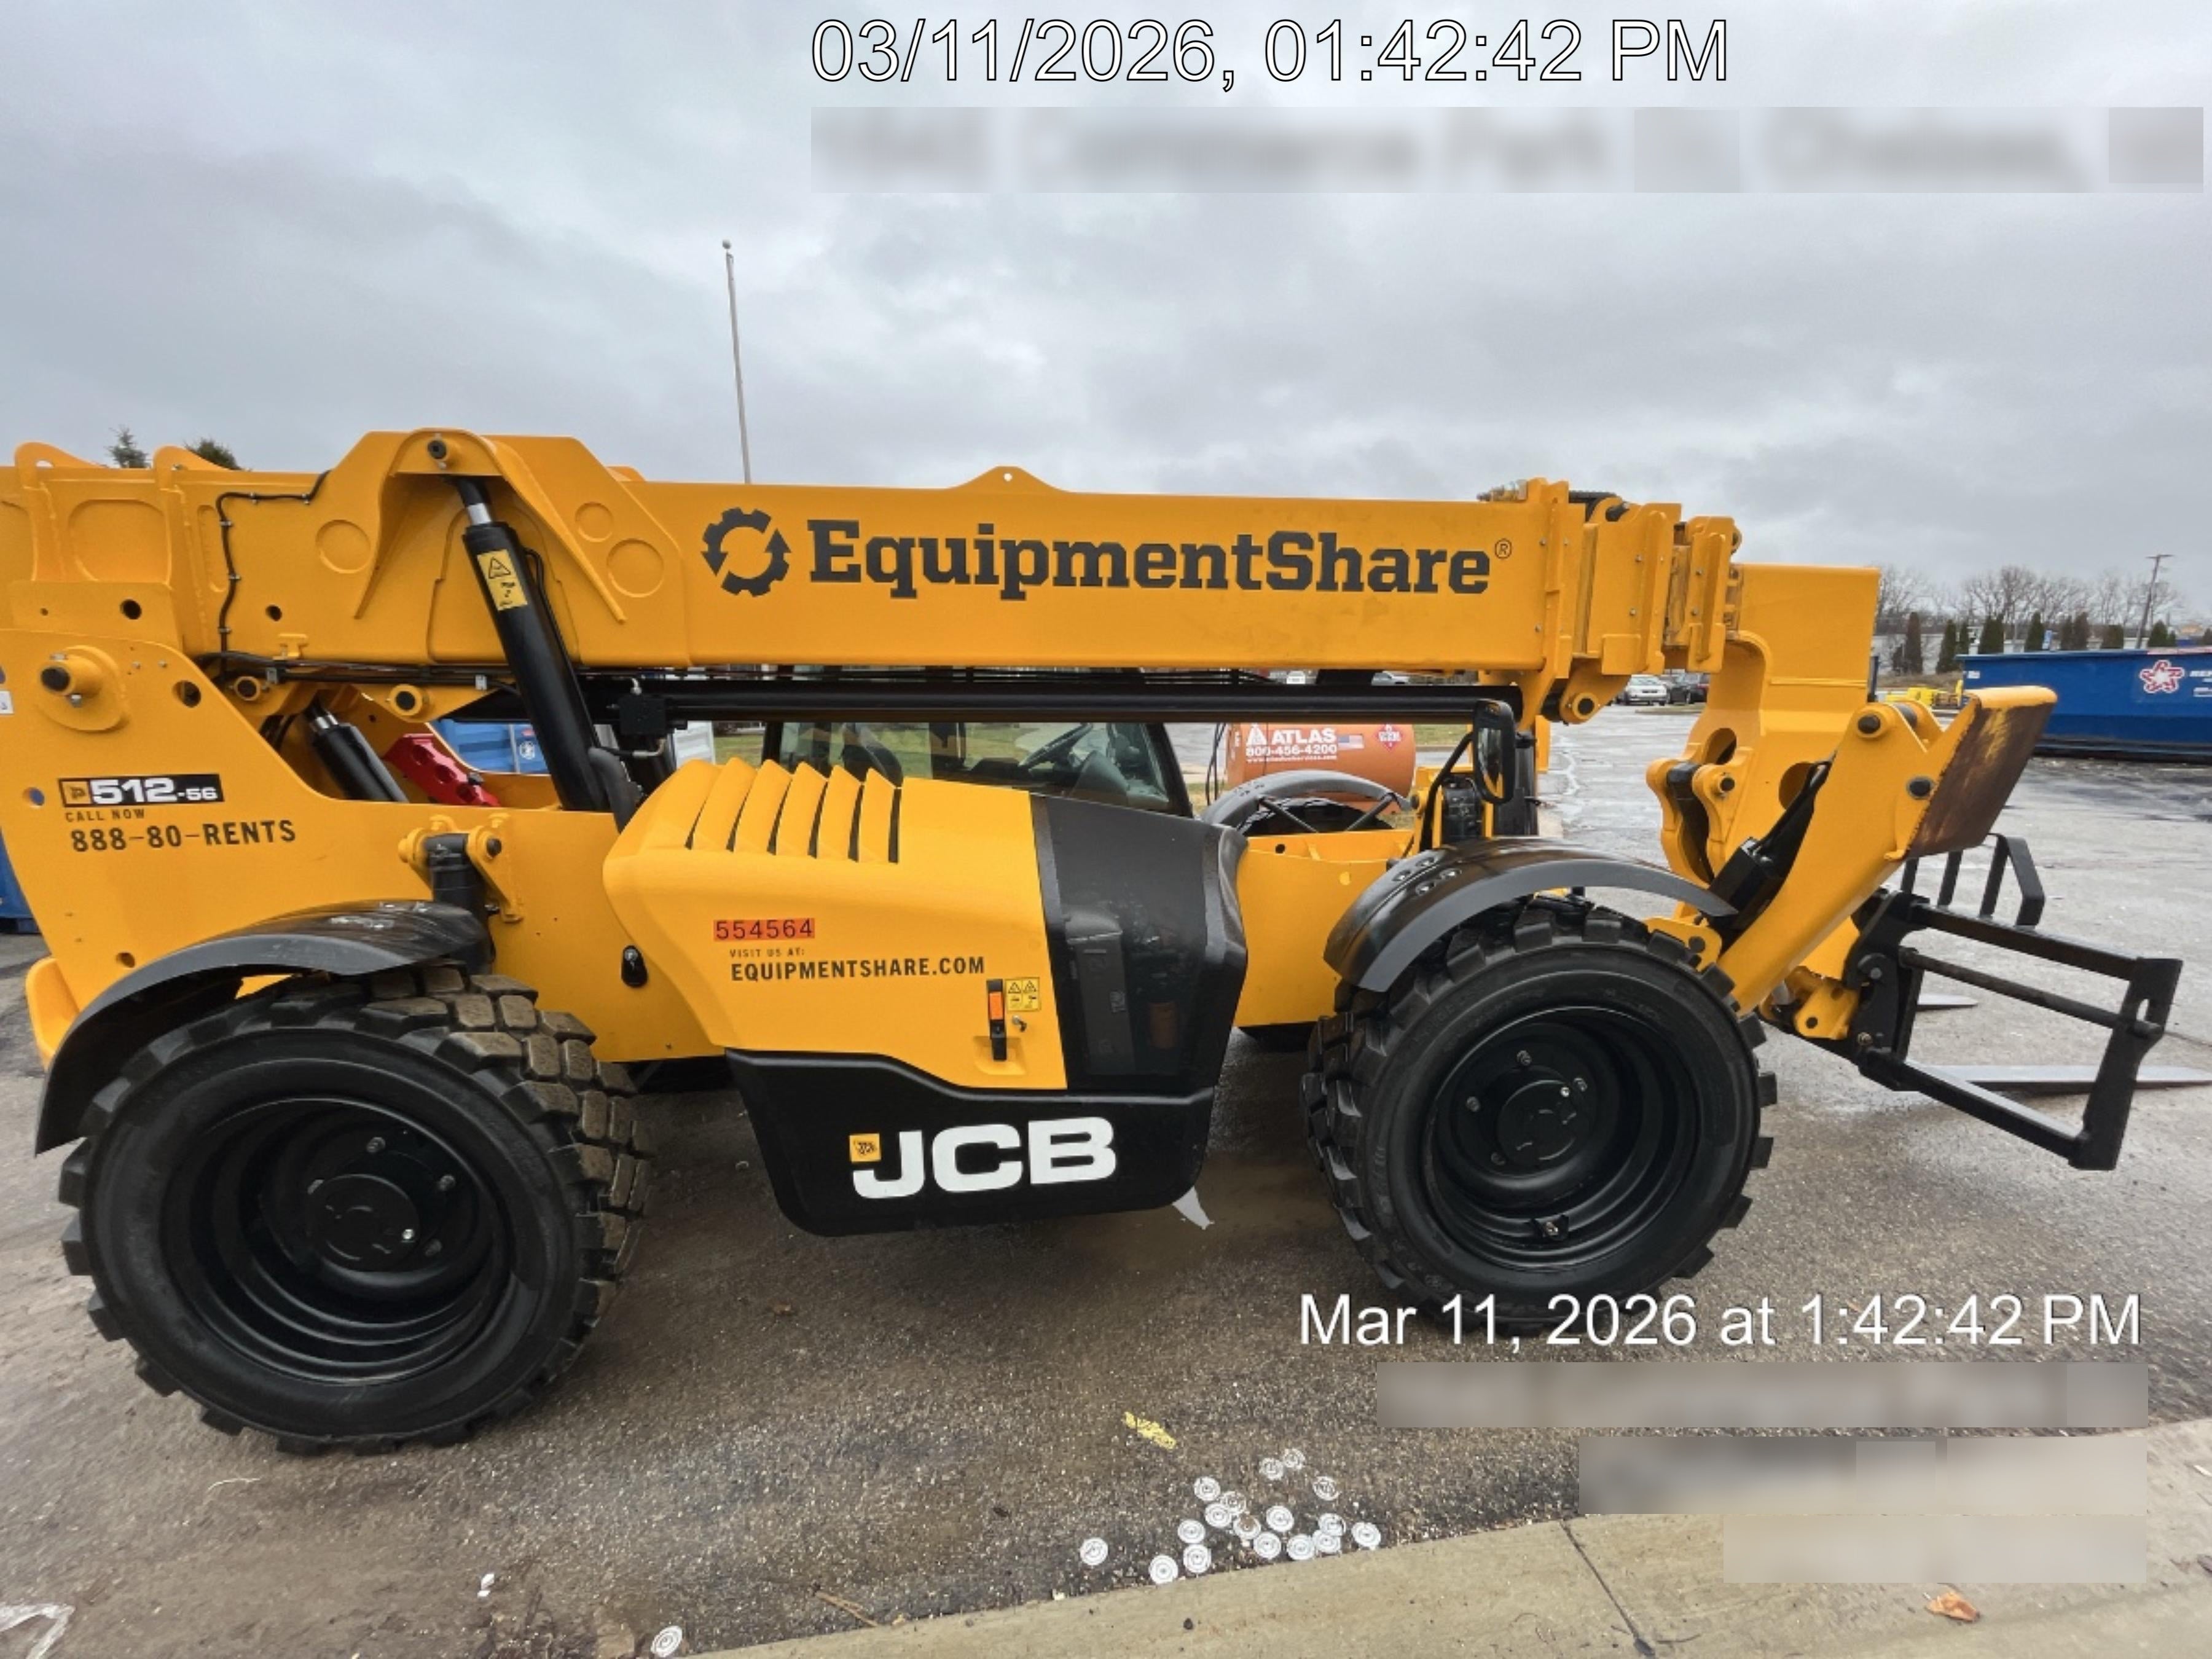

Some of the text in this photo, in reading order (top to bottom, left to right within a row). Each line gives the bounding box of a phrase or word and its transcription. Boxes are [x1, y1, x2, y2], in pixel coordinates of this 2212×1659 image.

[1271, 728, 1337, 745] ATLAS
[1245, 744, 1337, 756] 800-456-4200
[90, 777, 218, 804] 512-56
[65, 809, 145, 822] CALL NOW
[71, 819, 296, 852] 888-80-RENTS
[716, 919, 813, 939] 554564
[730, 947, 804, 957] VISIT US AT:
[731, 956, 984, 982] EQUIPMENTSHARE.COM
[853, 1117, 1116, 1199] JCB
